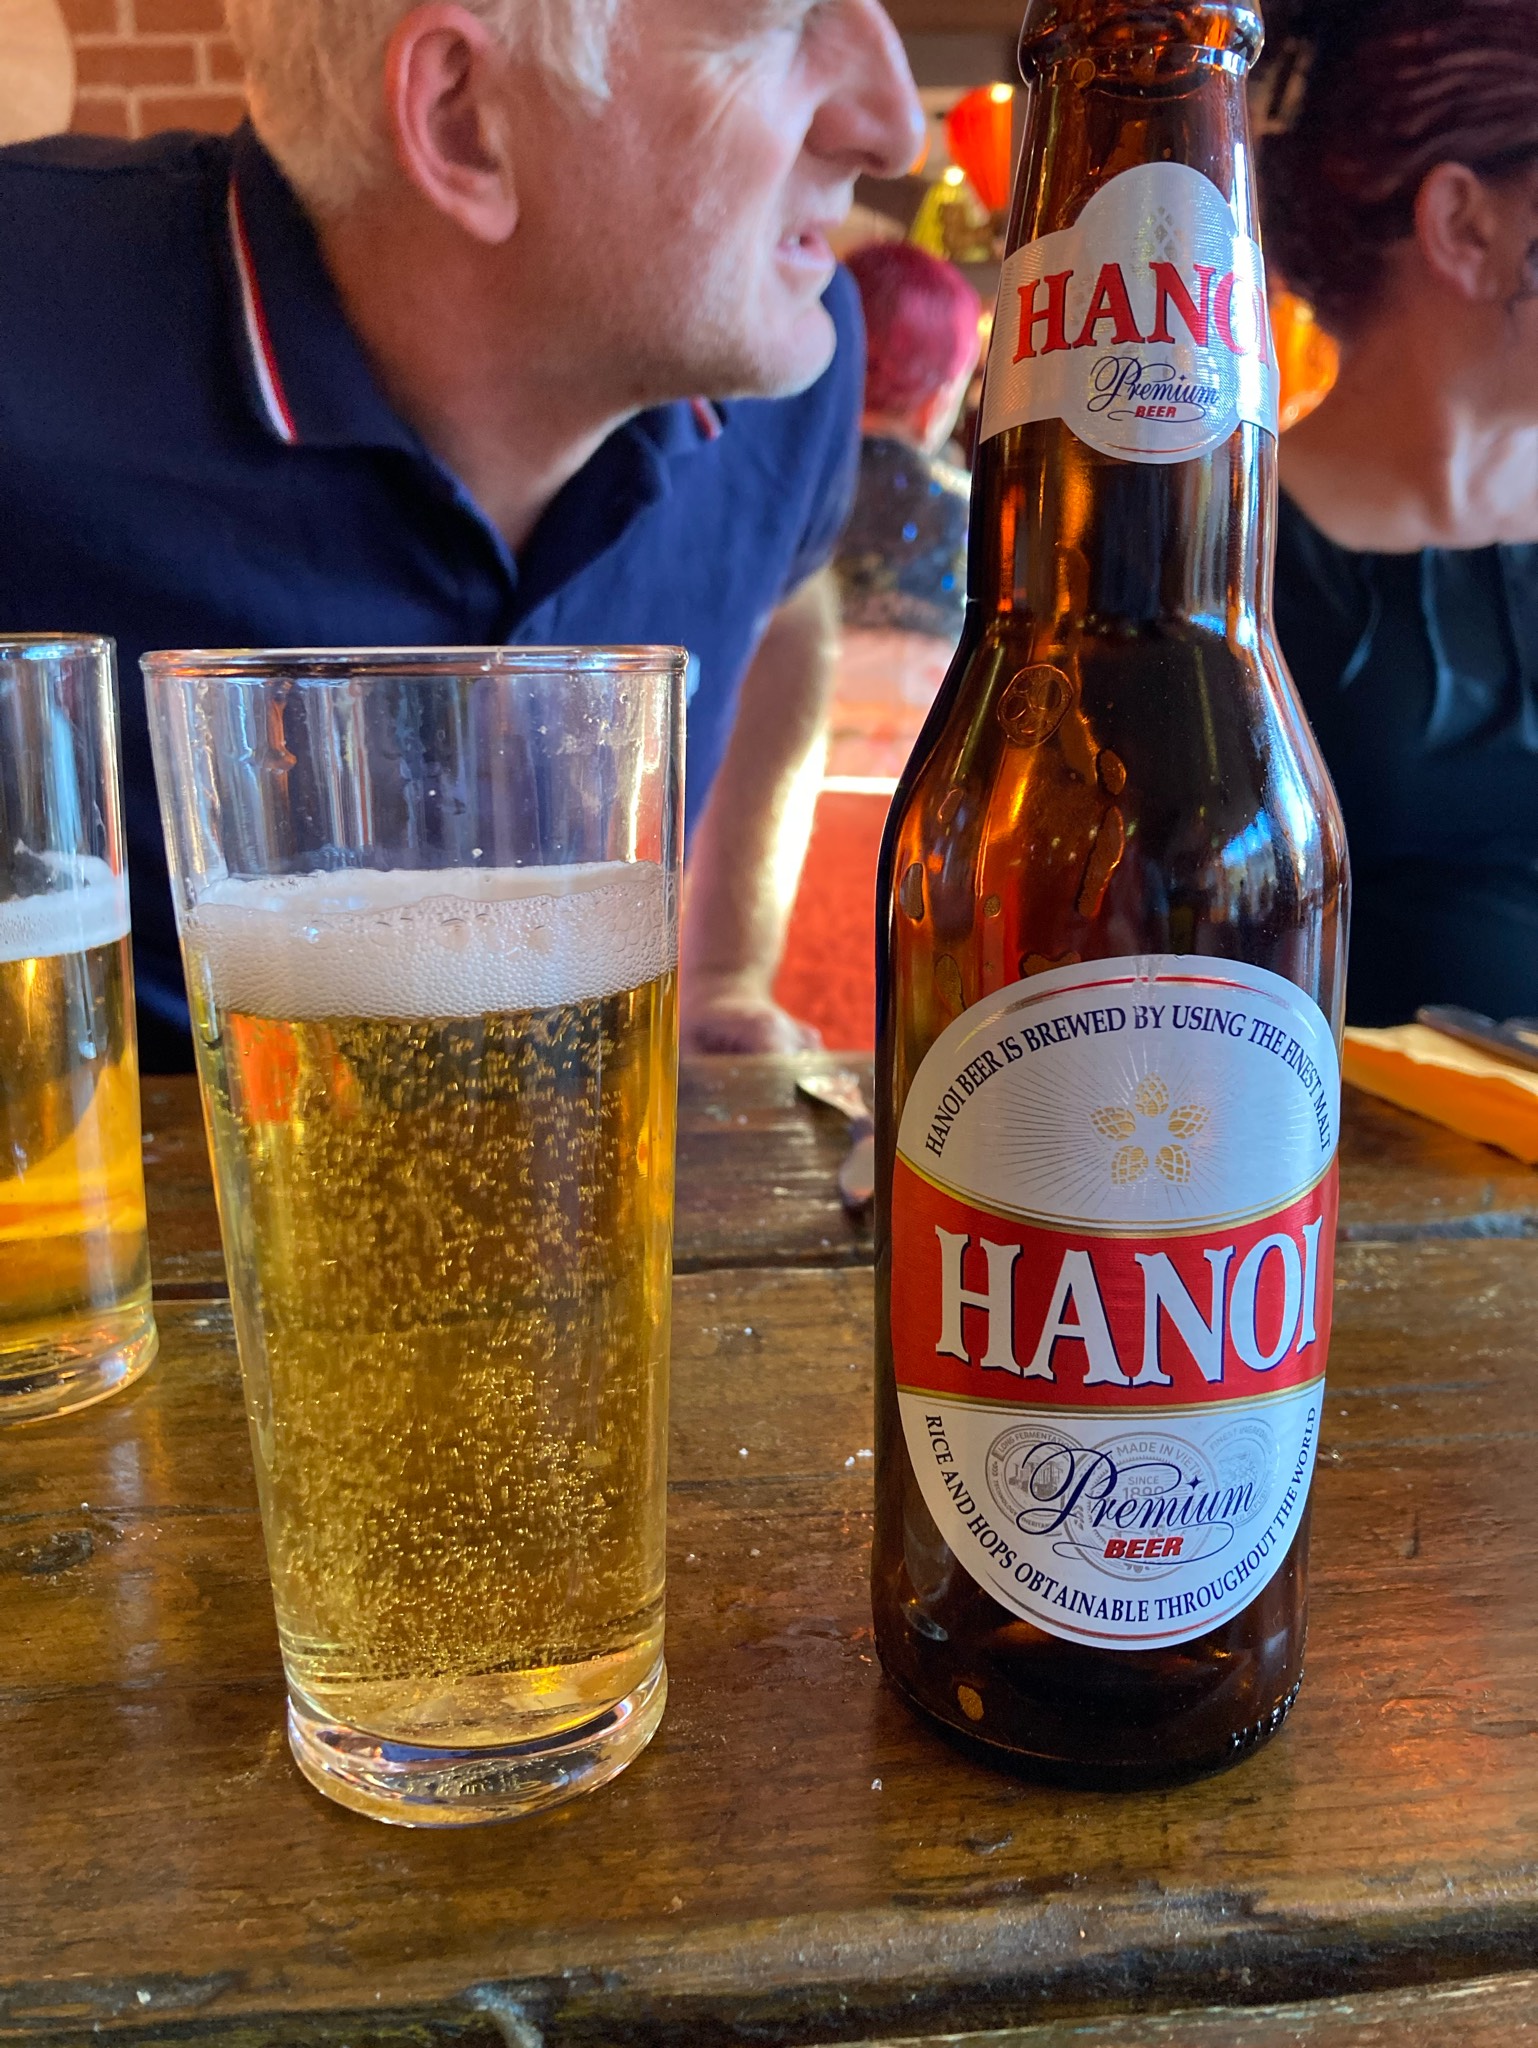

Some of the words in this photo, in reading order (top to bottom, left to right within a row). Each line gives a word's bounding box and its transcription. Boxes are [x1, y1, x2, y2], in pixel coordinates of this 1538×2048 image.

[1087, 355, 1220, 413] Premium
[1134, 405, 1178, 419] BEER
[925, 1085, 967, 1158] HANOI
[959, 1052, 1006, 1097] BEER
[998, 1037, 1024, 1065] IS
[1019, 1006, 1127, 1053] BREWED
[1133, 1005, 1167, 1029] BY
[1171, 1005, 1247, 1037] USING
[1249, 1017, 1289, 1053] THE
[1281, 1037, 1325, 1095] FINEST
[1312, 1088, 1333, 1152] MALT
[935, 1214, 1324, 1389] HANOI
[997, 1436, 1015, 1453] LONG
[1116, 1441, 1157, 1457] MADE
[1160, 1443, 1173, 1457] IN
[1176, 1450, 1208, 1496] VIETNM
[1016, 1440, 1257, 1536] Premium
[1127, 1475, 1160, 1485] SINCE
[925, 1414, 954, 1466] RICE
[941, 1469, 976, 1519] AND
[968, 1513, 1017, 1569] HOPS
[1014, 1562, 1151, 1623] OBTAINABLE
[1153, 1531, 1279, 1621] THROUGHOUT
[1272, 1486, 1299, 1530] THE
[1291, 1407, 1316, 1485] WORLD
[1103, 1536, 1185, 1560] BEER
